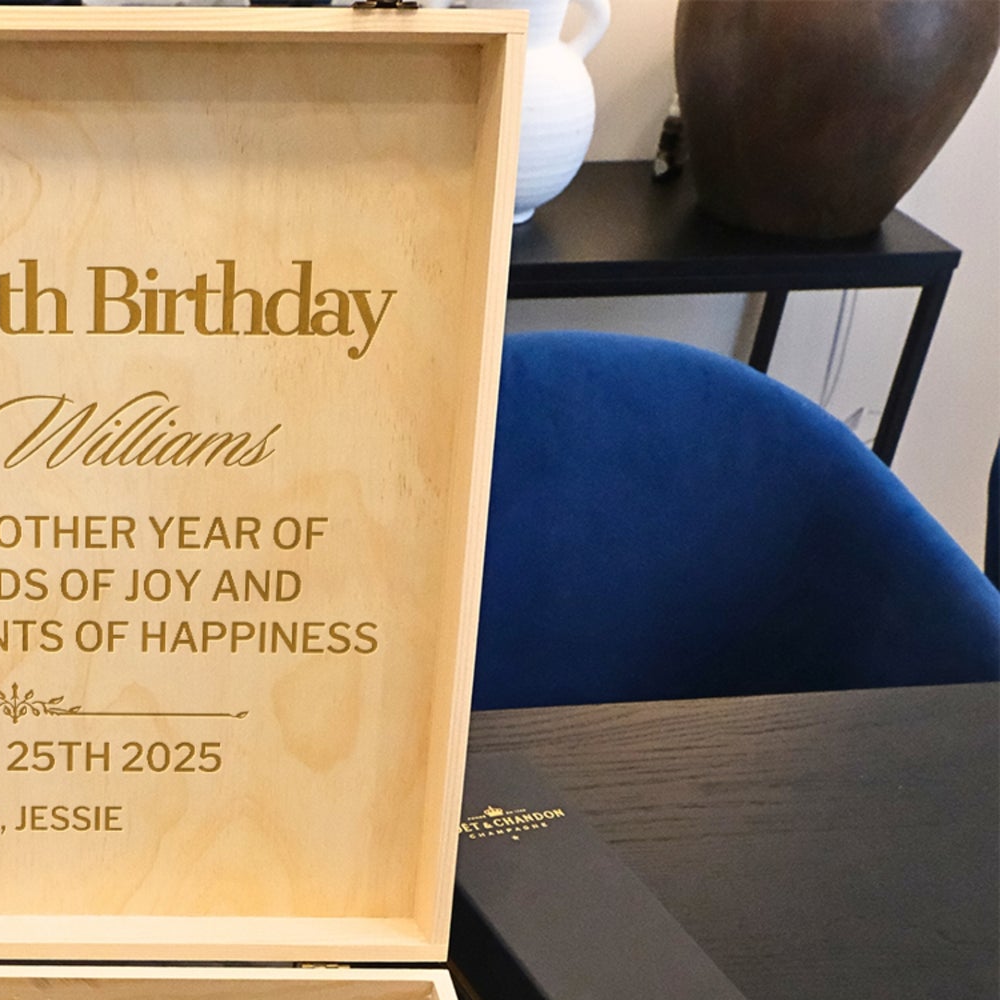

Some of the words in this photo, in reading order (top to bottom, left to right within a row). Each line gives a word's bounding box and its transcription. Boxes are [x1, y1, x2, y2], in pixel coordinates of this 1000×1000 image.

[85, 260, 397, 360] Birthday
[149, 516, 262, 550] YEAR
[272, 517, 329, 550] OF
[60, 568, 115, 602] OF
[124, 569, 202, 602] JOY
[212, 569, 302, 603] AND
[75, 620, 130, 653] OF
[140, 620, 379, 655] HAPPINESS
[6, 741, 111, 773] 25TH
[121, 741, 223, 773] 2025
[15, 806, 124, 832] JESSIE
[493, 808, 566, 828] CHANDON
